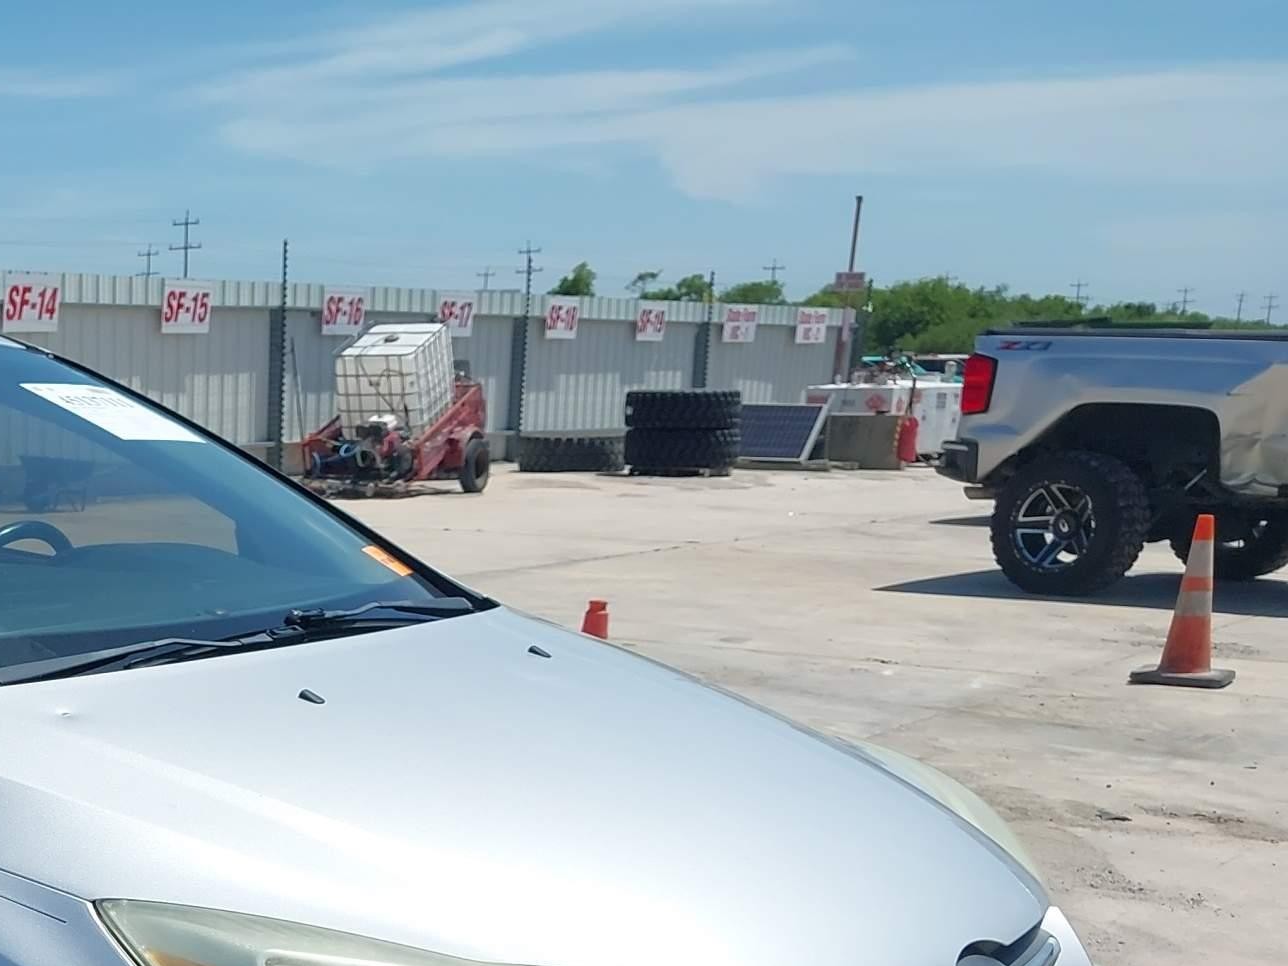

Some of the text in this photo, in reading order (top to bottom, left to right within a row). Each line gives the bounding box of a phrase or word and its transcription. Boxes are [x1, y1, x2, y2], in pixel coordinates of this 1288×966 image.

[6, 284, 59, 321] SF-14
[164, 290, 210, 323] SF-15
[324, 294, 364, 326] SF-16
